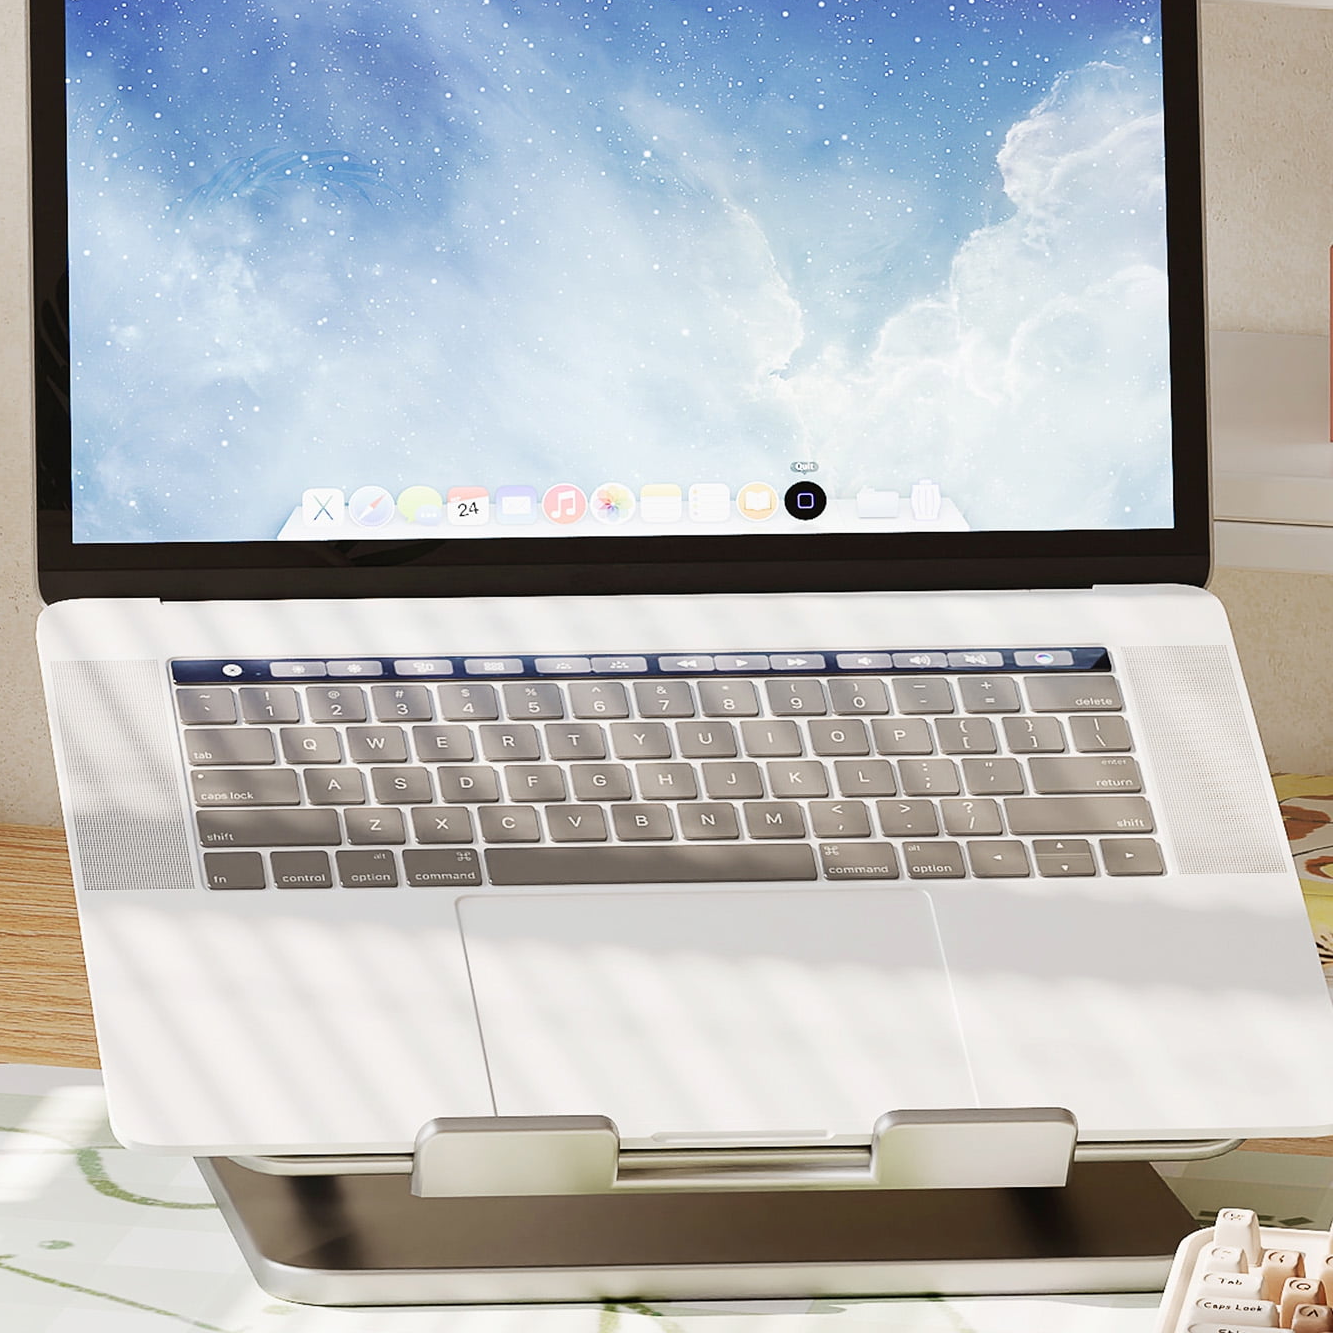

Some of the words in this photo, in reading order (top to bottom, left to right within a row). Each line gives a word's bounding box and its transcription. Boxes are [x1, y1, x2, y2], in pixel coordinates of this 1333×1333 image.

[457, 501, 479, 517] 24
[328, 691, 340, 699] @
[396, 690, 404, 698] #
[525, 688, 537, 696] %
[656, 686, 667, 694] &
[265, 691, 269, 700] !
[594, 701, 605, 711] 6
[659, 700, 669, 710] 7
[723, 699, 735, 709] 8
[791, 698, 802, 709] 9
[854, 697, 865, 708] 0
[1076, 697, 1113, 706] delete
[266, 706, 273, 716] 1
[331, 705, 342, 715] 2
[397, 704, 408, 714] 3
[463, 703, 473, 712] 4
[529, 702, 540, 712] 5
[568, 735, 579, 745] T
[633, 734, 645, 744] Y
[699, 733, 712, 744] U
[831, 731, 844, 742] O
[894, 730, 906, 740] P
[304, 739, 317, 750] Q
[366, 738, 384, 748] W
[437, 737, 448, 747] E
[502, 736, 514, 746] R
[194, 751, 212, 759] tab
[528, 776, 537, 786] F
[593, 775, 606, 786] G
[658, 774, 672, 785] H
[727, 773, 736, 784] J
[789, 772, 802, 783] K
[859, 771, 870, 782] L
[328, 779, 341, 789] A
[395, 778, 407, 789] S
[460, 777, 473, 788] D
[201, 793, 227, 801] caps
[230, 792, 253, 800] lock
[963, 802, 973, 813] ?
[435, 818, 448, 829] X
[502, 817, 515, 828] C
[568, 816, 581, 827] V
[636, 816, 648, 826] B
[701, 815, 715, 825] N
[766, 814, 782, 824] M
[1117, 819, 1144, 827] shift
[369, 819, 381, 830] Z
[207, 833, 233, 841] shift
[913, 865, 952, 873] option
[283, 874, 325, 882] control
[352, 874, 390, 882] option
[415, 872, 475, 880] command
[1204, 1302, 1231, 1310] Caps
[1236, 1304, 1263, 1312] Lock
